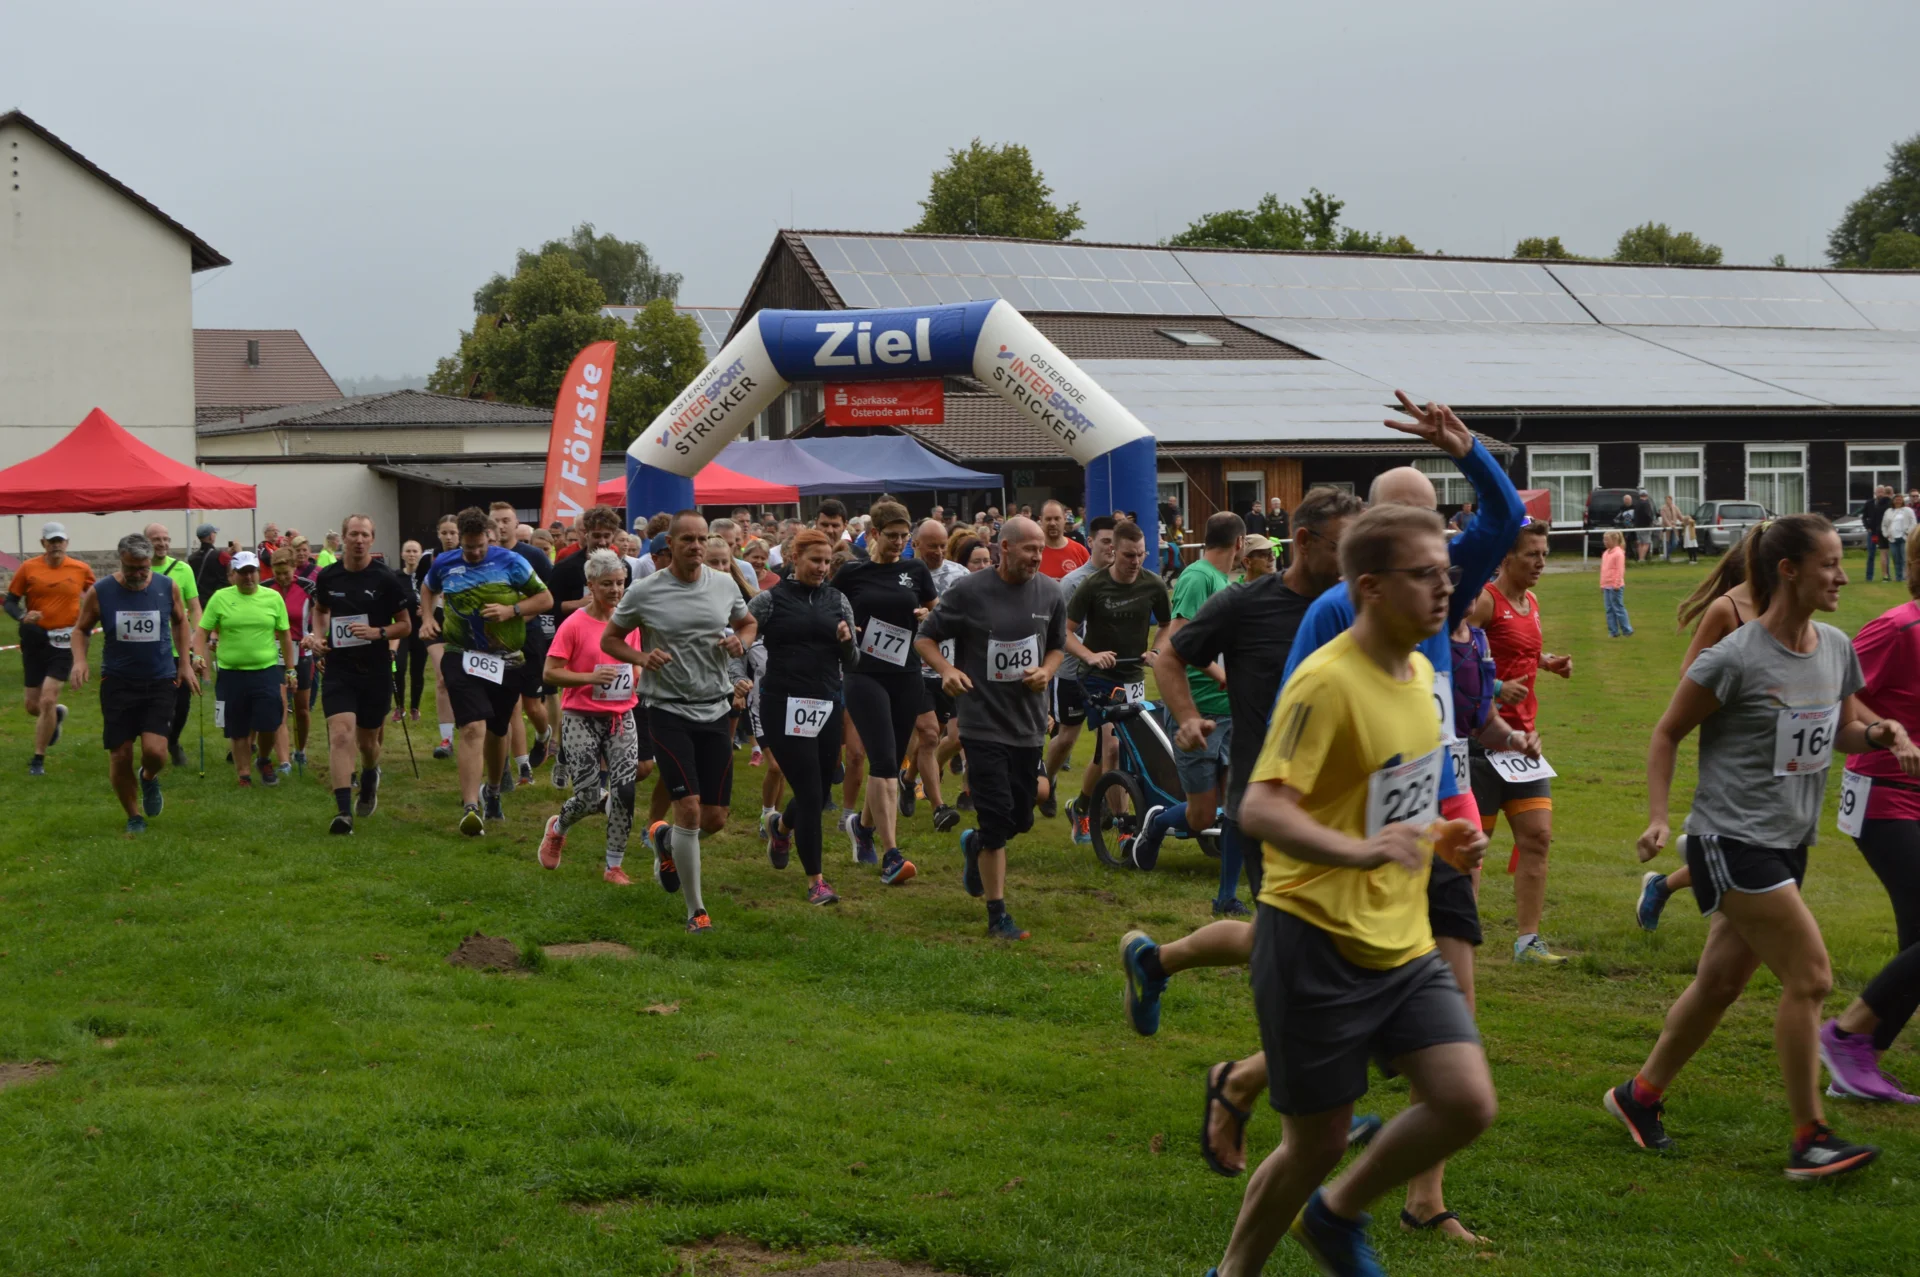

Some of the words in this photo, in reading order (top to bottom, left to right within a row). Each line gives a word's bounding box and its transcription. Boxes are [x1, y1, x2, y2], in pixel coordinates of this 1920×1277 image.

[813, 318, 932, 366] Ziel
[670, 364, 720, 416] OSTERODE
[1009, 357, 1094, 434] INTERSPORT
[1030, 353, 1087, 404] OSTERODE
[669, 356, 746, 436] INTERSPORT
[851, 396, 898, 407] Sparkasse
[851, 408, 893, 418] Osterode
[894, 409, 910, 417] am
[911, 407, 934, 416] Harz
[993, 366, 1077, 446] STRICKER
[561, 363, 603, 487] Förste
[674, 376, 758, 455] STRICKER
[123, 619, 154, 633] 149
[336, 624, 353, 639] 00
[873, 631, 906, 653] 177
[469, 655, 499, 674] 065
[995, 649, 1033, 670] 048
[794, 708, 827, 727] 047
[1793, 722, 1833, 756] 164
[1500, 755, 1541, 774] 100
[1383, 774, 1433, 826] 223
